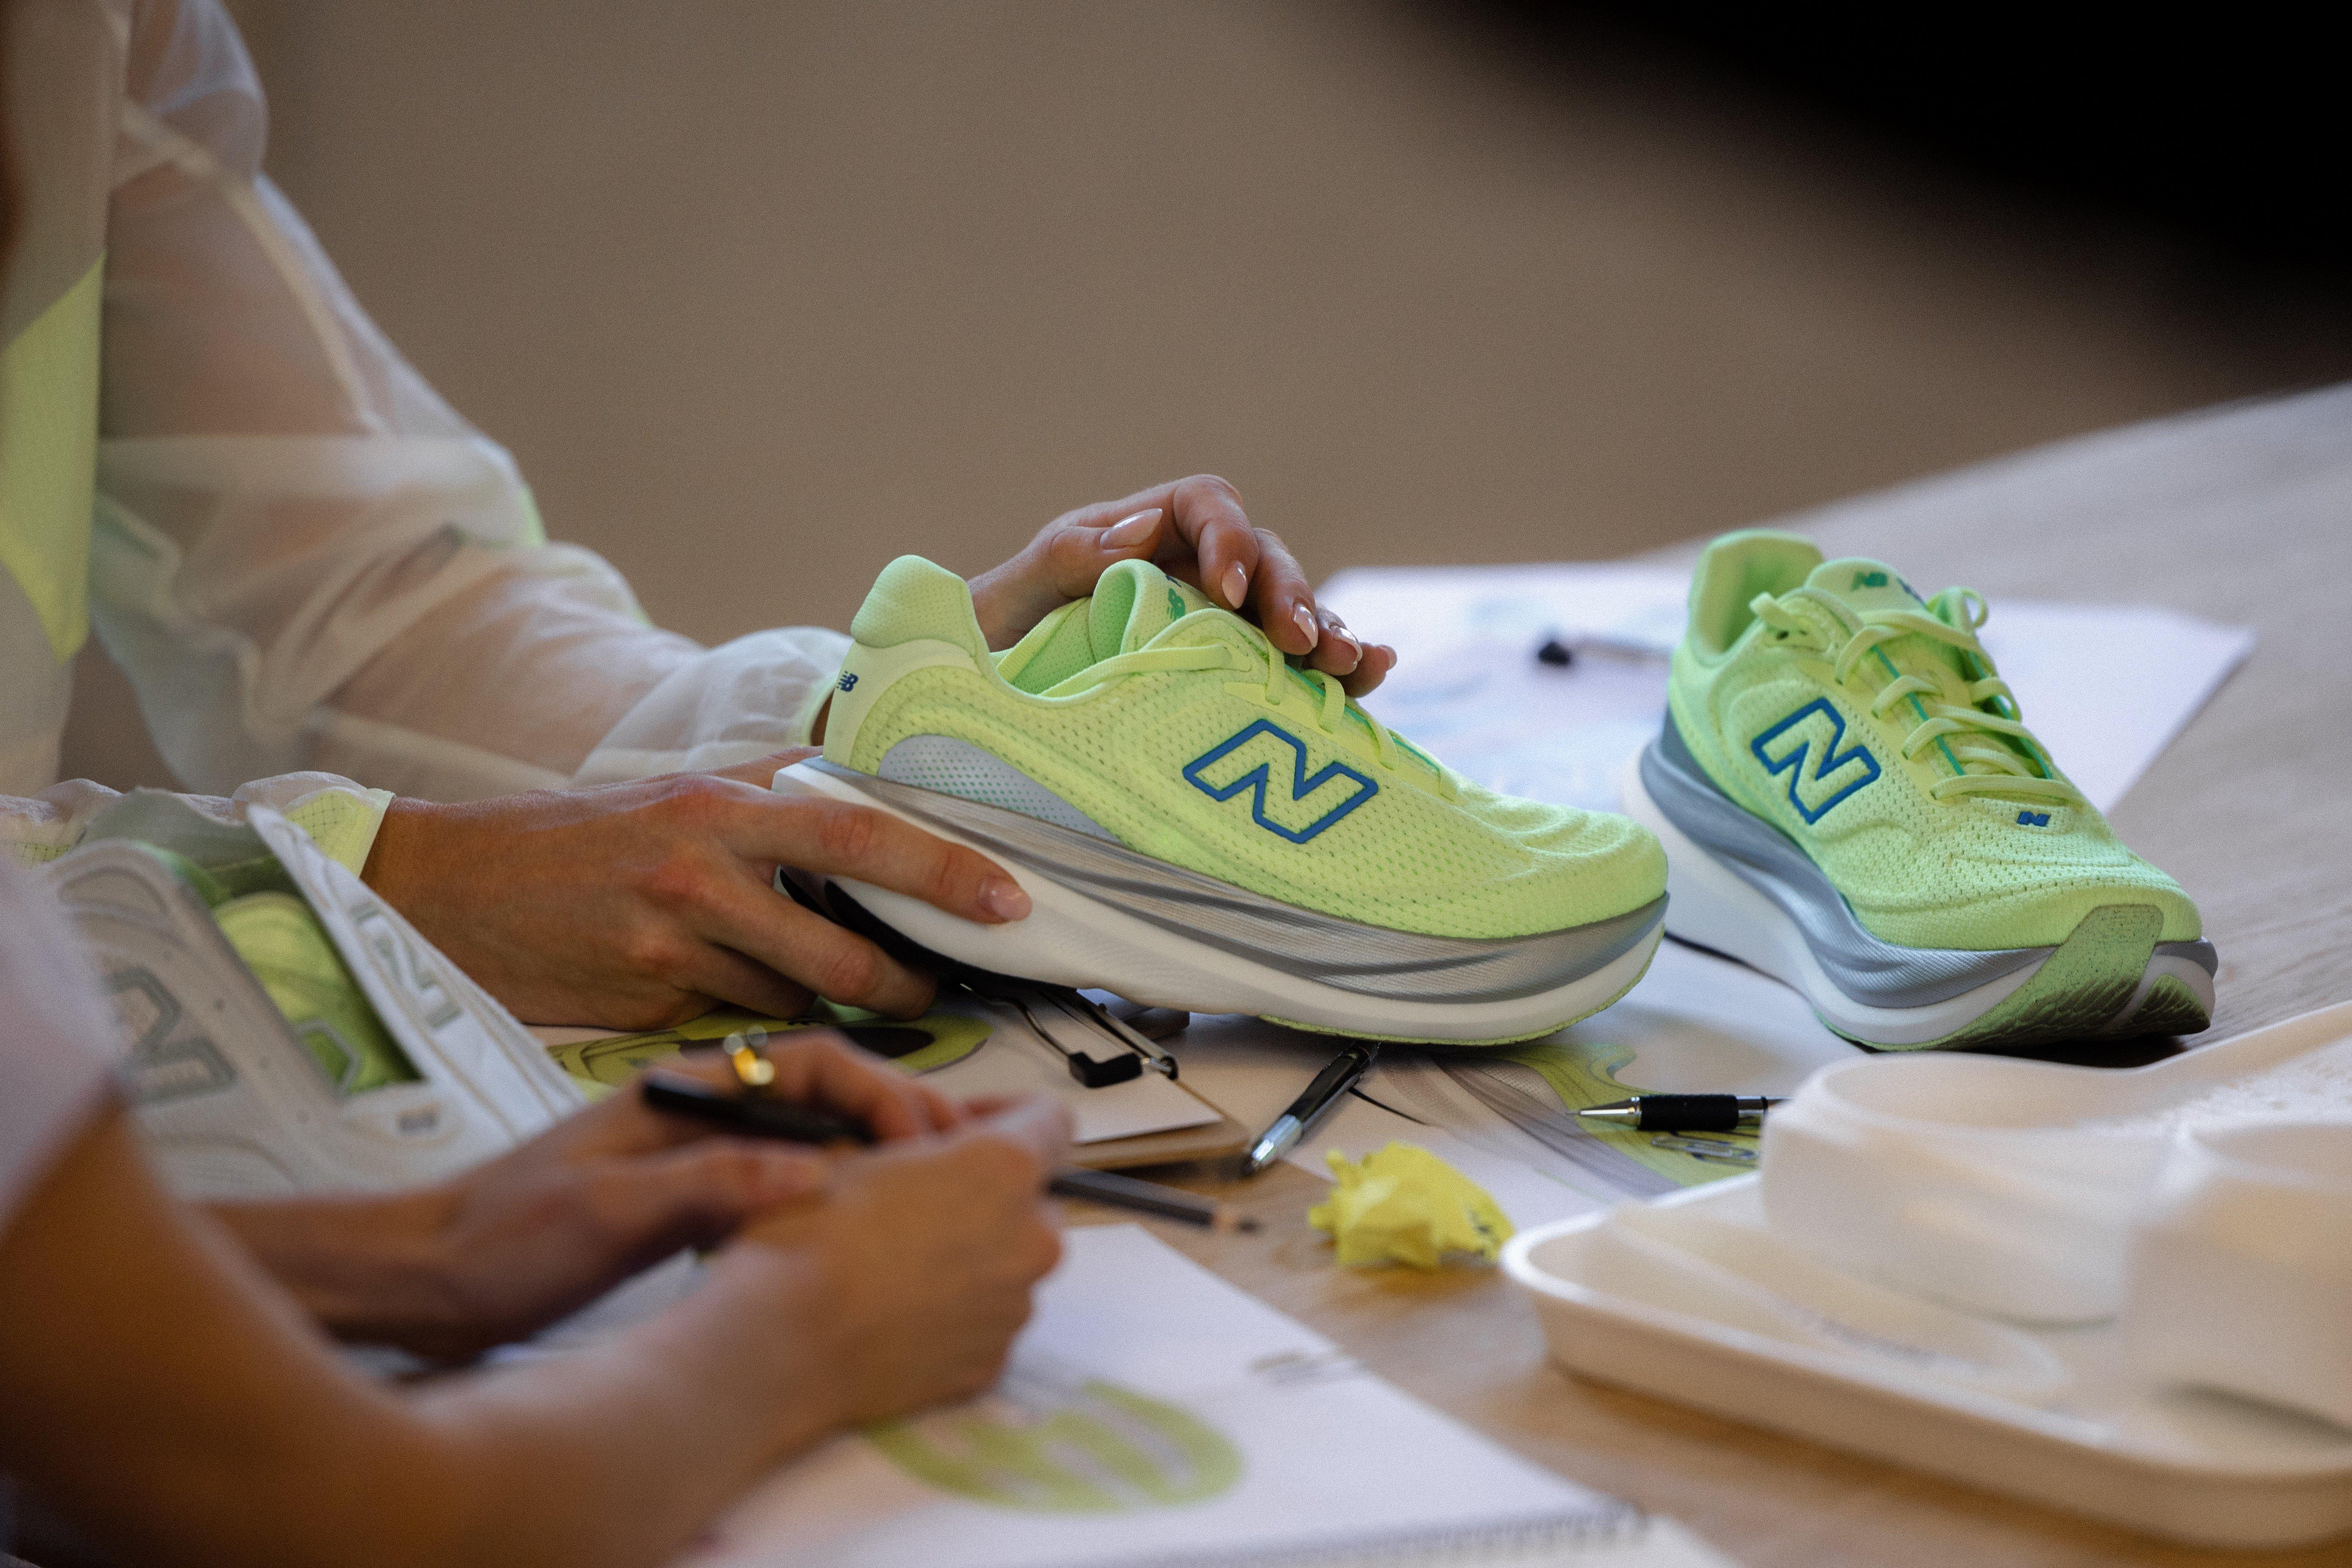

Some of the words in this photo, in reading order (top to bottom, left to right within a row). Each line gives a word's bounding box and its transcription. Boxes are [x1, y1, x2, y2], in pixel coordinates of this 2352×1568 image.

[1182, 719, 1379, 844] N
[1751, 697, 1881, 825] N
[2017, 811, 2051, 827] N
